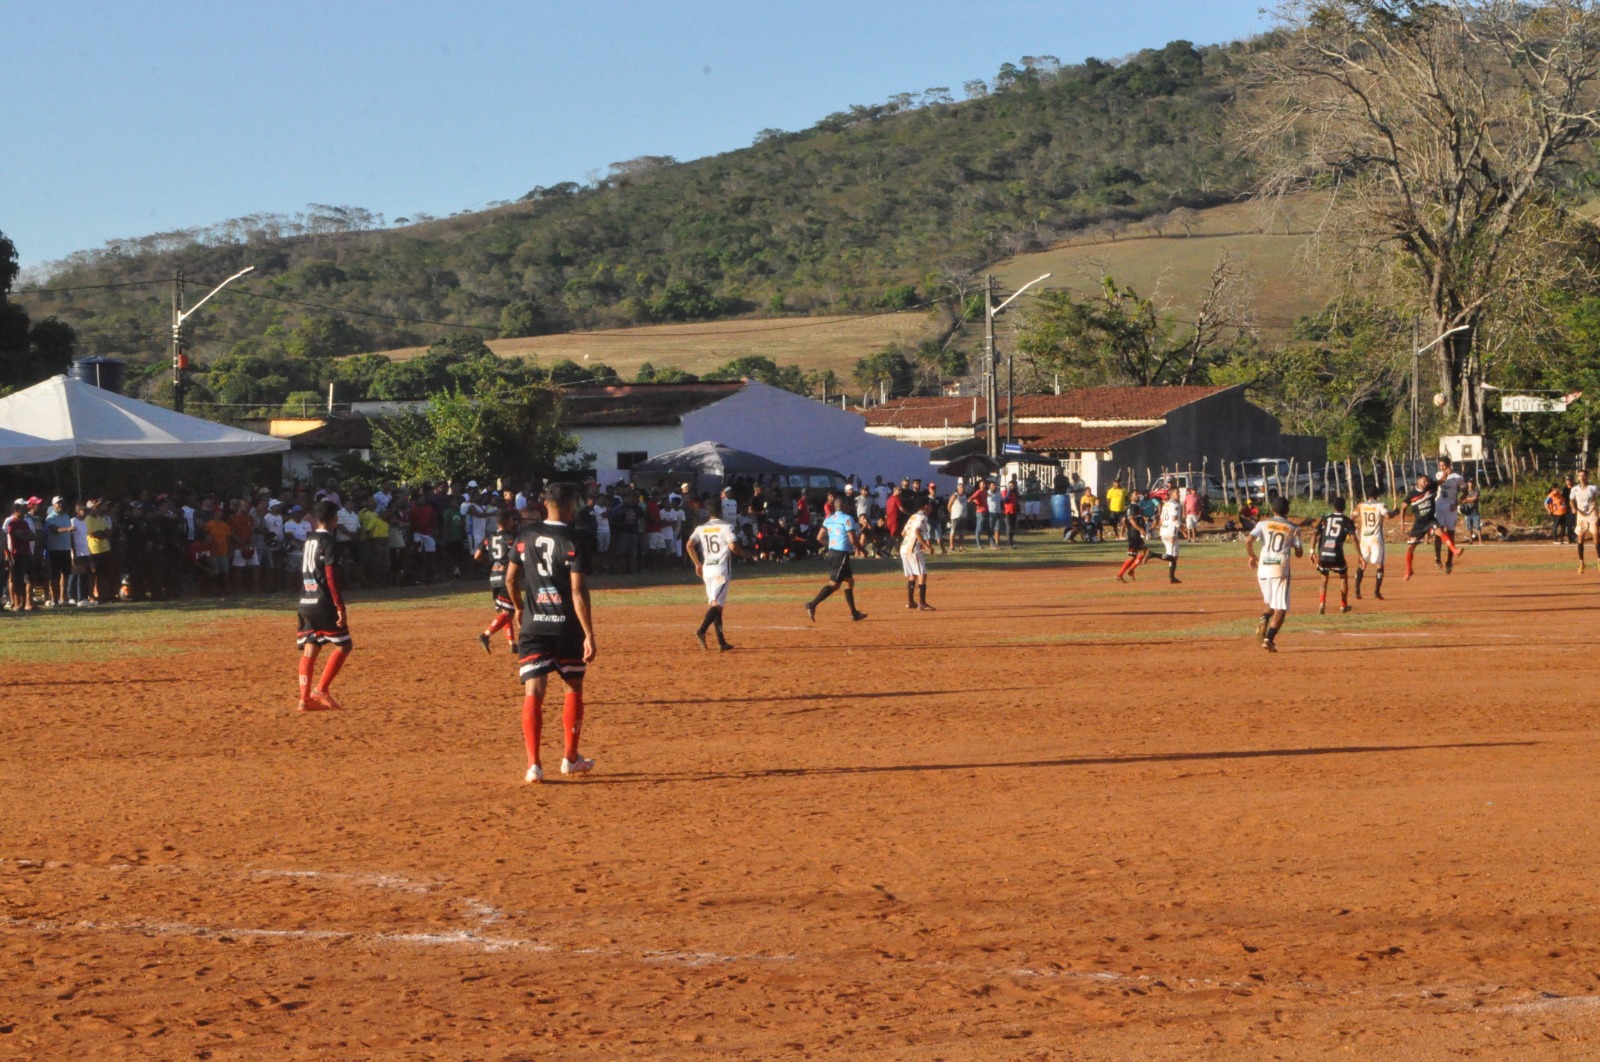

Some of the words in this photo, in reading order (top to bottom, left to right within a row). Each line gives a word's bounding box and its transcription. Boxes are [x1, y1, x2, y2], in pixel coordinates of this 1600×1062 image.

[1325, 517, 1344, 537] 15
[1364, 511, 1376, 527] 19
[492, 535, 502, 560] 5
[704, 534, 720, 554] 16
[1268, 531, 1284, 552] 10
[302, 539, 318, 574] 10
[535, 535, 555, 577] 3
[299, 674, 308, 685] 10
